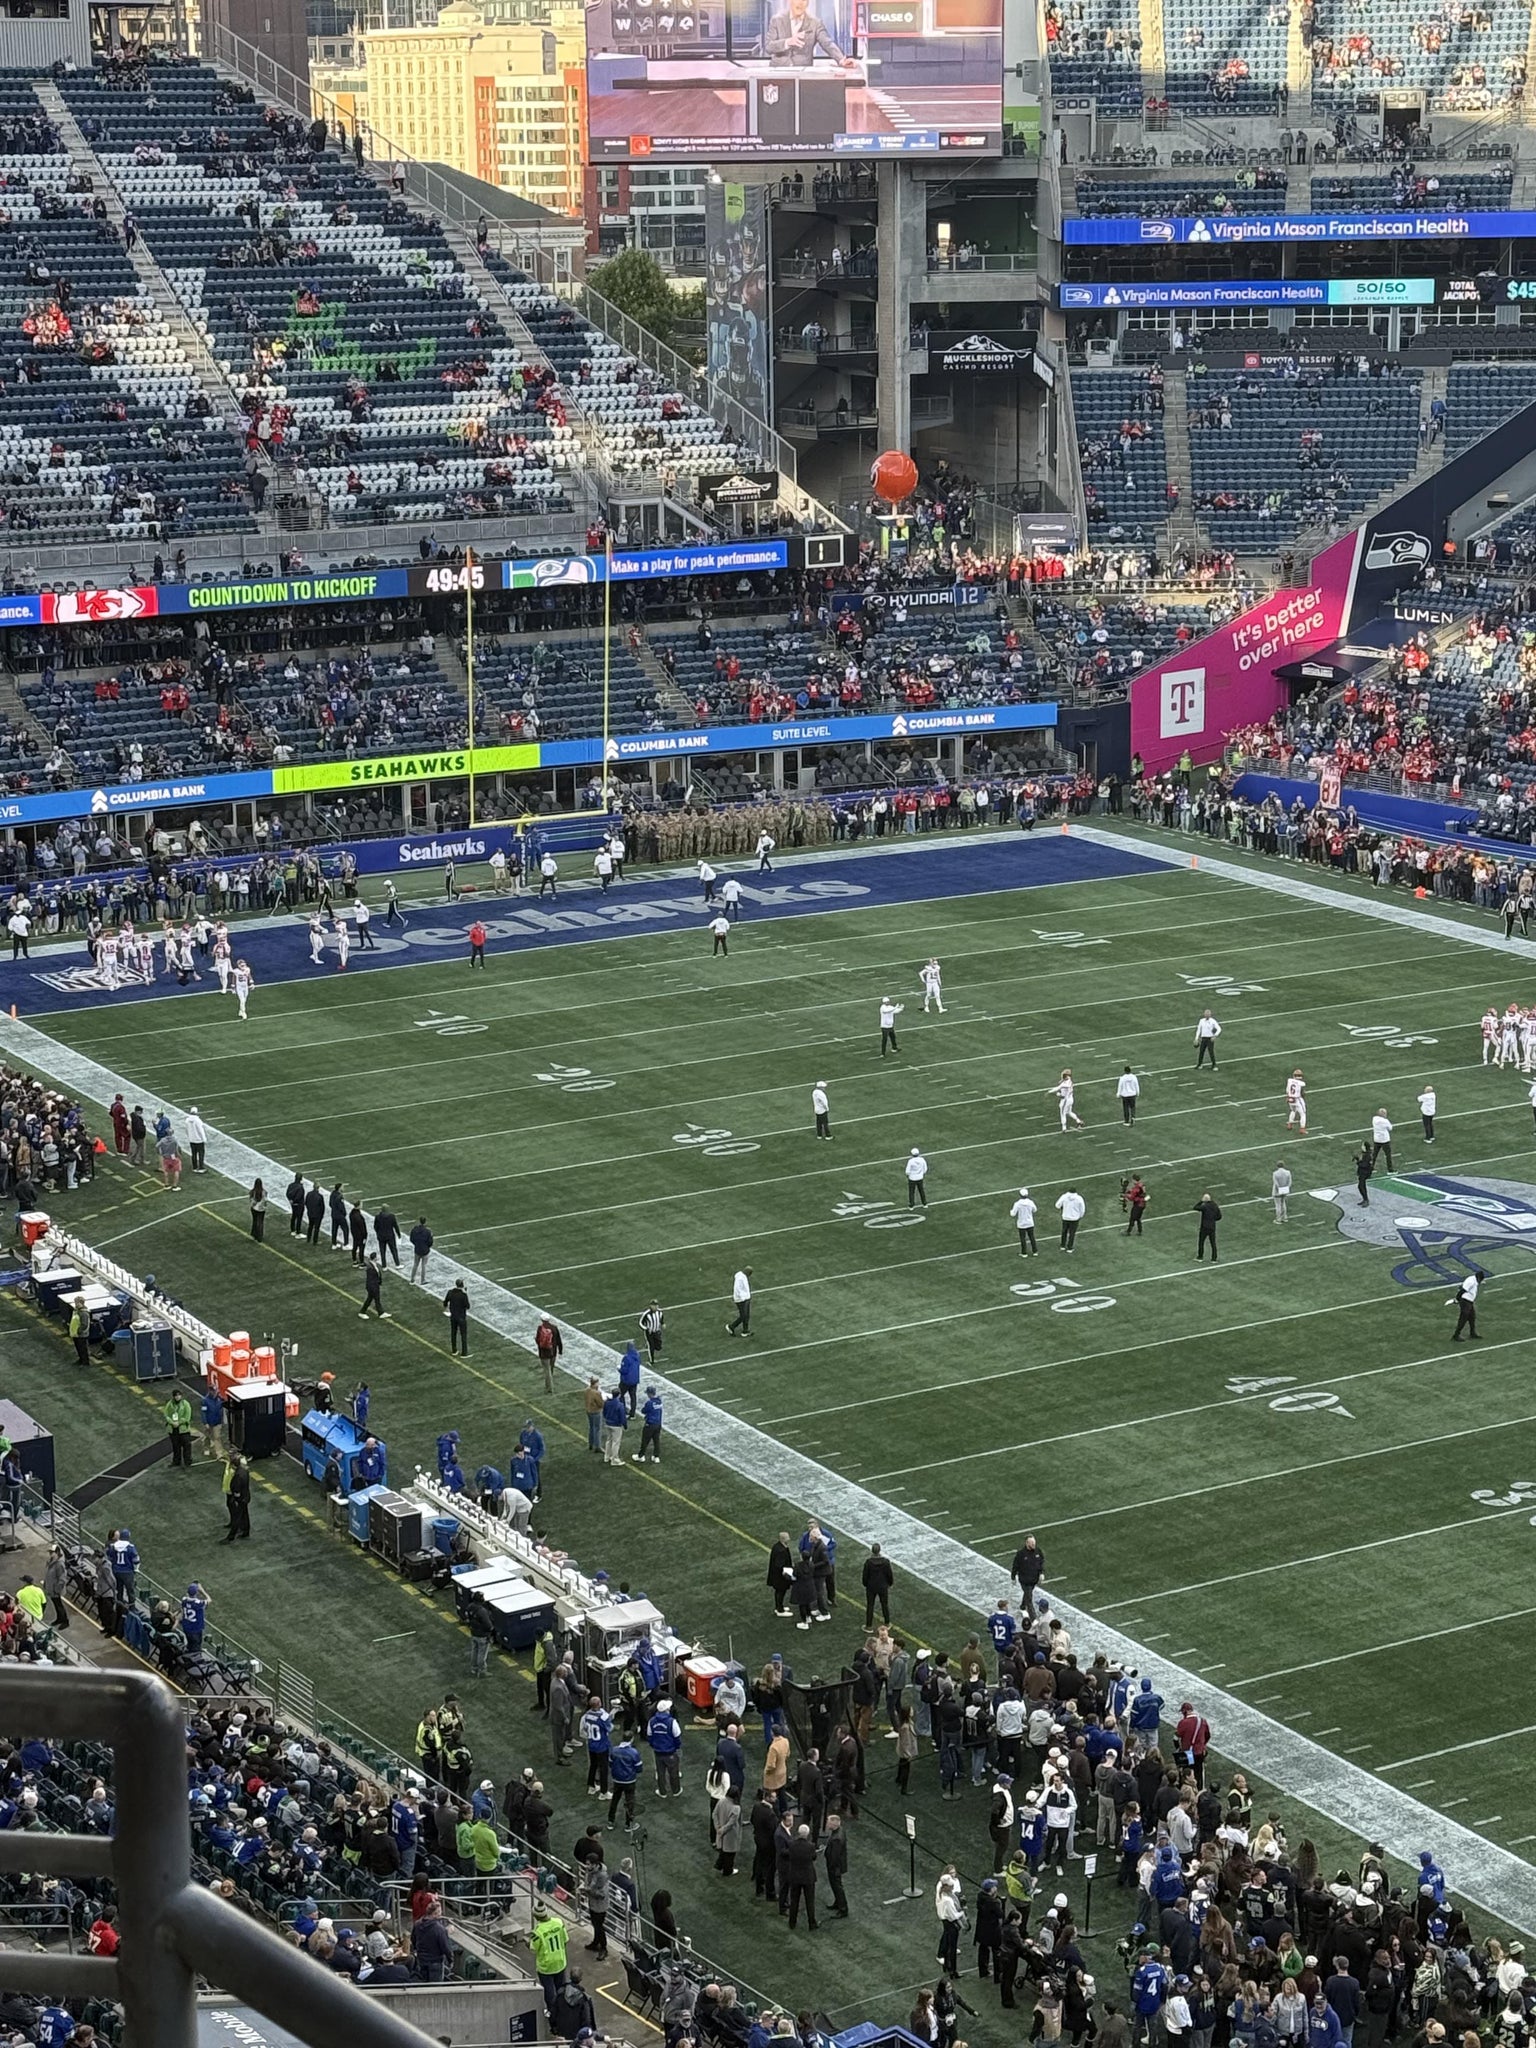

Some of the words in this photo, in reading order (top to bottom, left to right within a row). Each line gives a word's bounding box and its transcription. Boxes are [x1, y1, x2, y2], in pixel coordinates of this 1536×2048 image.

[871, 13, 904, 23] CHASE
[1055, 99, 1090, 109] 300
[1385, 92, 1417, 103] 301
[1212, 221, 1269, 241] Virginia
[1273, 221, 1326, 237] Mason
[1329, 220, 1413, 236] Franciscan
[1416, 218, 1469, 235] Health
[1356, 282, 1406, 293] 50/50
[1449, 281, 1476, 290] TOTAL
[1122, 289, 1168, 304] Virginia
[1171, 288, 1212, 301] Mason
[1213, 287, 1279, 300] Franciscan
[1281, 286, 1323, 299] Health
[943, 354, 1015, 364] MUCKLESHOOT
[611, 559, 640, 575] Make
[642, 562, 649, 572] a
[650, 558, 671, 575] play
[673, 556, 688, 570] for
[690, 555, 714, 571] peak
[717, 551, 781, 569] performance.
[426, 567, 485, 593] 49:45
[188, 584, 290, 609] COUNTDOWN
[293, 582, 311, 601] TO
[314, 576, 377, 600] KICKOFF
[961, 587, 979, 604] 12
[1232, 624, 1262, 652] It's
[1265, 586, 1323, 632] better
[1394, 607, 1454, 624] LUMEN
[1239, 635, 1282, 672] over
[1283, 610, 1325, 650] here
[909, 715, 964, 730] COLUMBIA
[966, 713, 995, 725] BANK
[772, 728, 800, 741] SUITE
[802, 726, 831, 738] LEVEL
[620, 738, 676, 753] COLUMBIA
[678, 736, 709, 749] BANK
[350, 755, 466, 781] SEAHAWKS
[109, 788, 171, 806] COLUMBIA
[173, 784, 206, 798] BANK
[399, 838, 486, 863] Seahawks
[323, 879, 872, 957] Seahawks
[1008, 1276, 1117, 1314] 50
[1224, 1375, 1341, 1413] 40
[994, 1625, 1006, 1641] 12
[687, 1676, 696, 1697] G
[1021, 1822, 1034, 1840] 14
[549, 1935, 560, 1952] 11
[1147, 1978, 1158, 1996] 4
[39, 2023, 53, 2044] 54
[210, 2011, 267, 2045] Mobile
